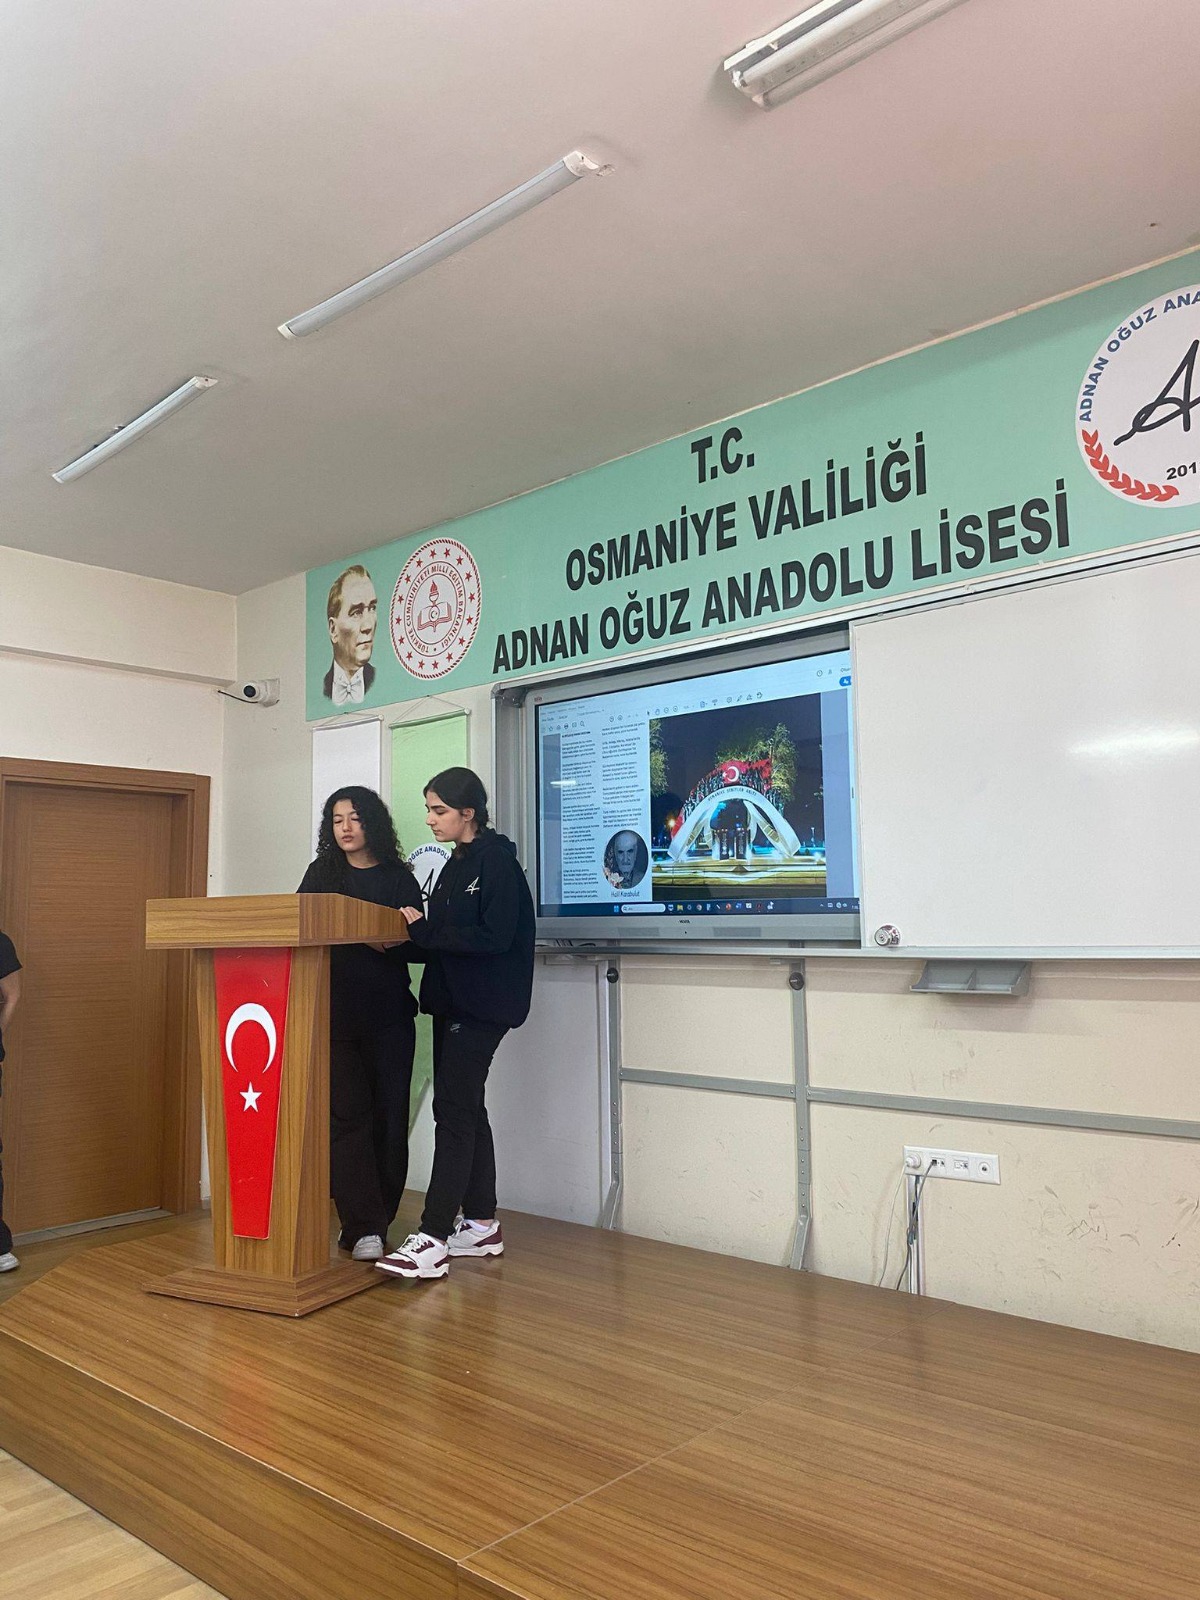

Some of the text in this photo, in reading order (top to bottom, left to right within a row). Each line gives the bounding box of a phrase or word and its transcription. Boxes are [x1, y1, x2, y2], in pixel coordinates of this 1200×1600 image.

[1079, 357, 1109, 422] ADNAN
[1107, 306, 1157, 353] OĞUZ
[565, 430, 928, 591] OSMANİYE VALİLİĞİ
[691, 426, 755, 484] T.C.
[492, 478, 1071, 675] ADNAN OĞUZ ANADOLU LİSESİ
